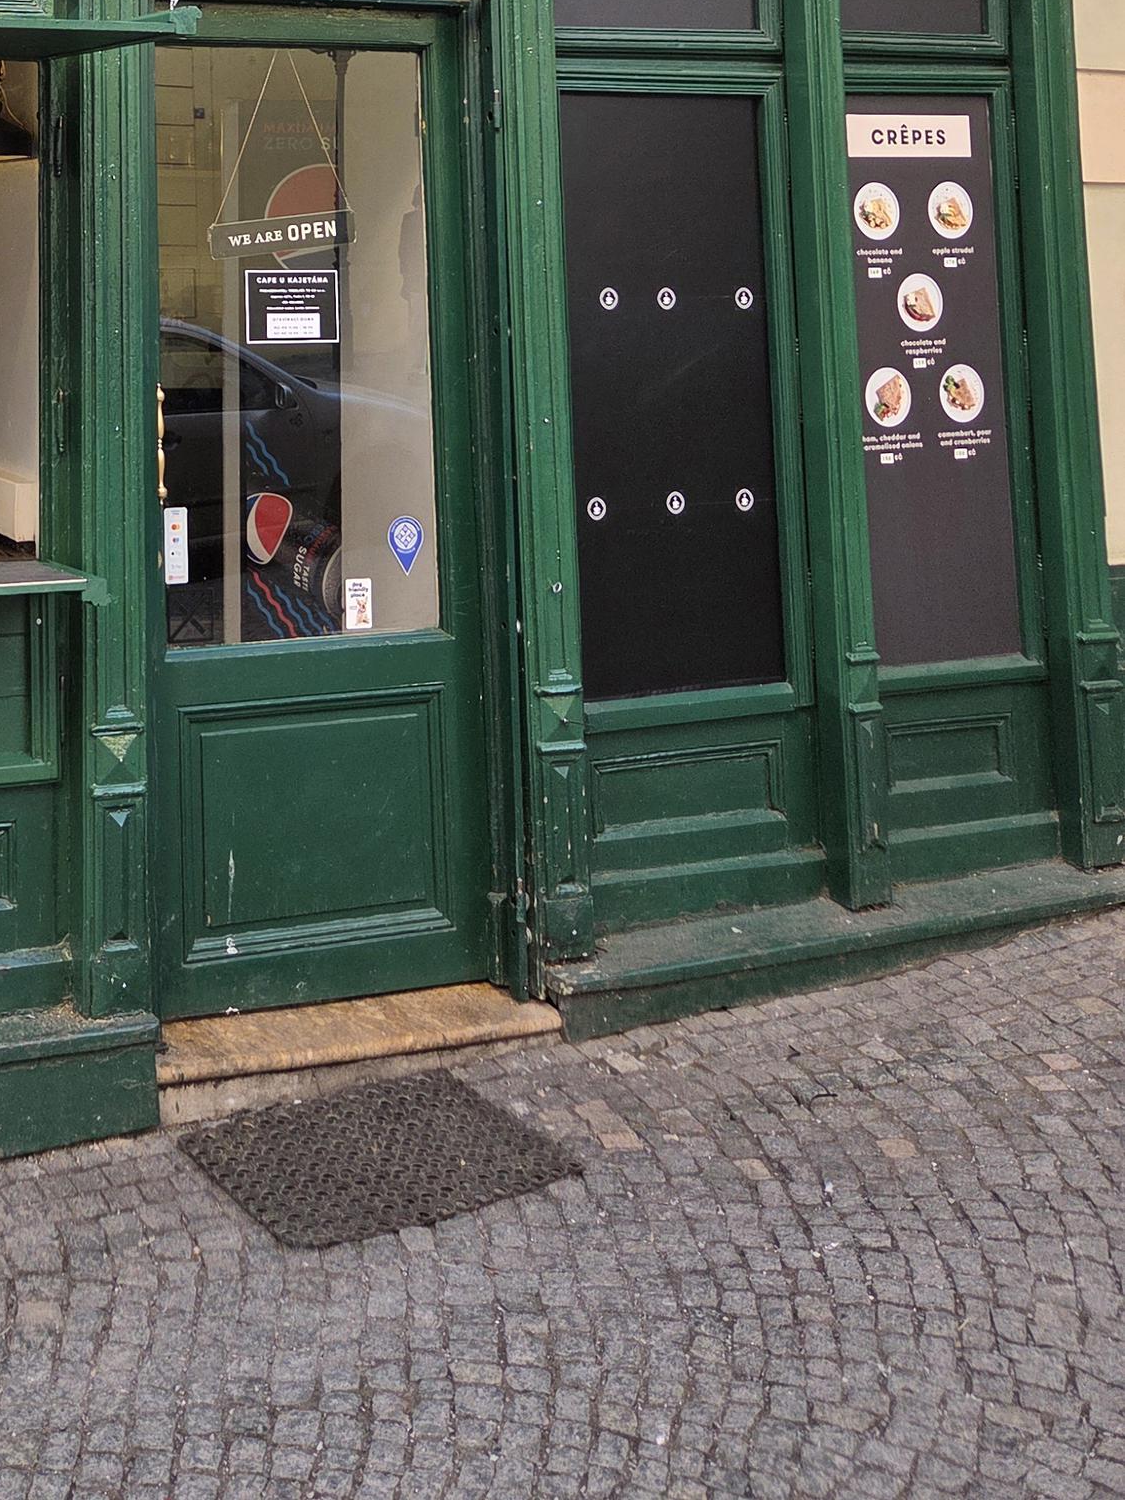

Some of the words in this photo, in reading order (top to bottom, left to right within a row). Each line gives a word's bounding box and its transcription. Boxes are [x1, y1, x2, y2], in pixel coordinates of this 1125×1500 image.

[871, 124, 947, 146] CRÊPES
[228, 233, 252, 247] WE
[255, 230, 283, 244] ARE
[287, 219, 337, 242] OPEN
